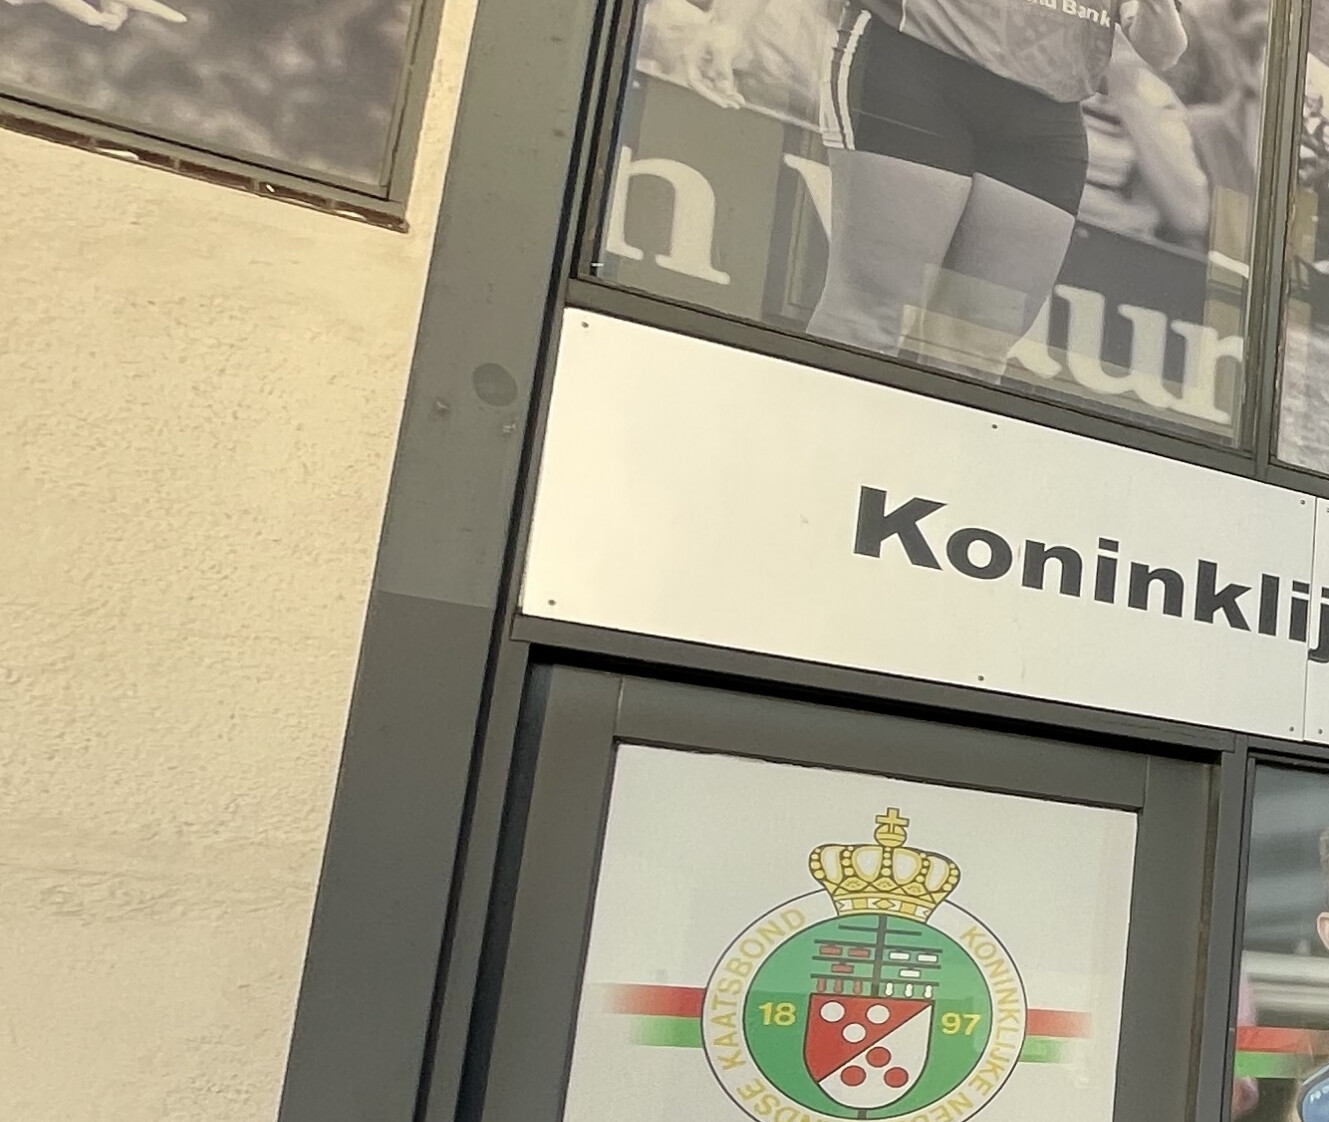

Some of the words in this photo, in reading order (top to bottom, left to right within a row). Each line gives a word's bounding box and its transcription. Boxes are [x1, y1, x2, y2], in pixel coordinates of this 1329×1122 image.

[1062, 0, 1111, 28] Bank
[711, 908, 807, 1071] KAATSBOND
[959, 925, 1022, 1098] KONINKLIJKE
[758, 1002, 797, 1027] 18
[941, 1012, 981, 1037] 97
